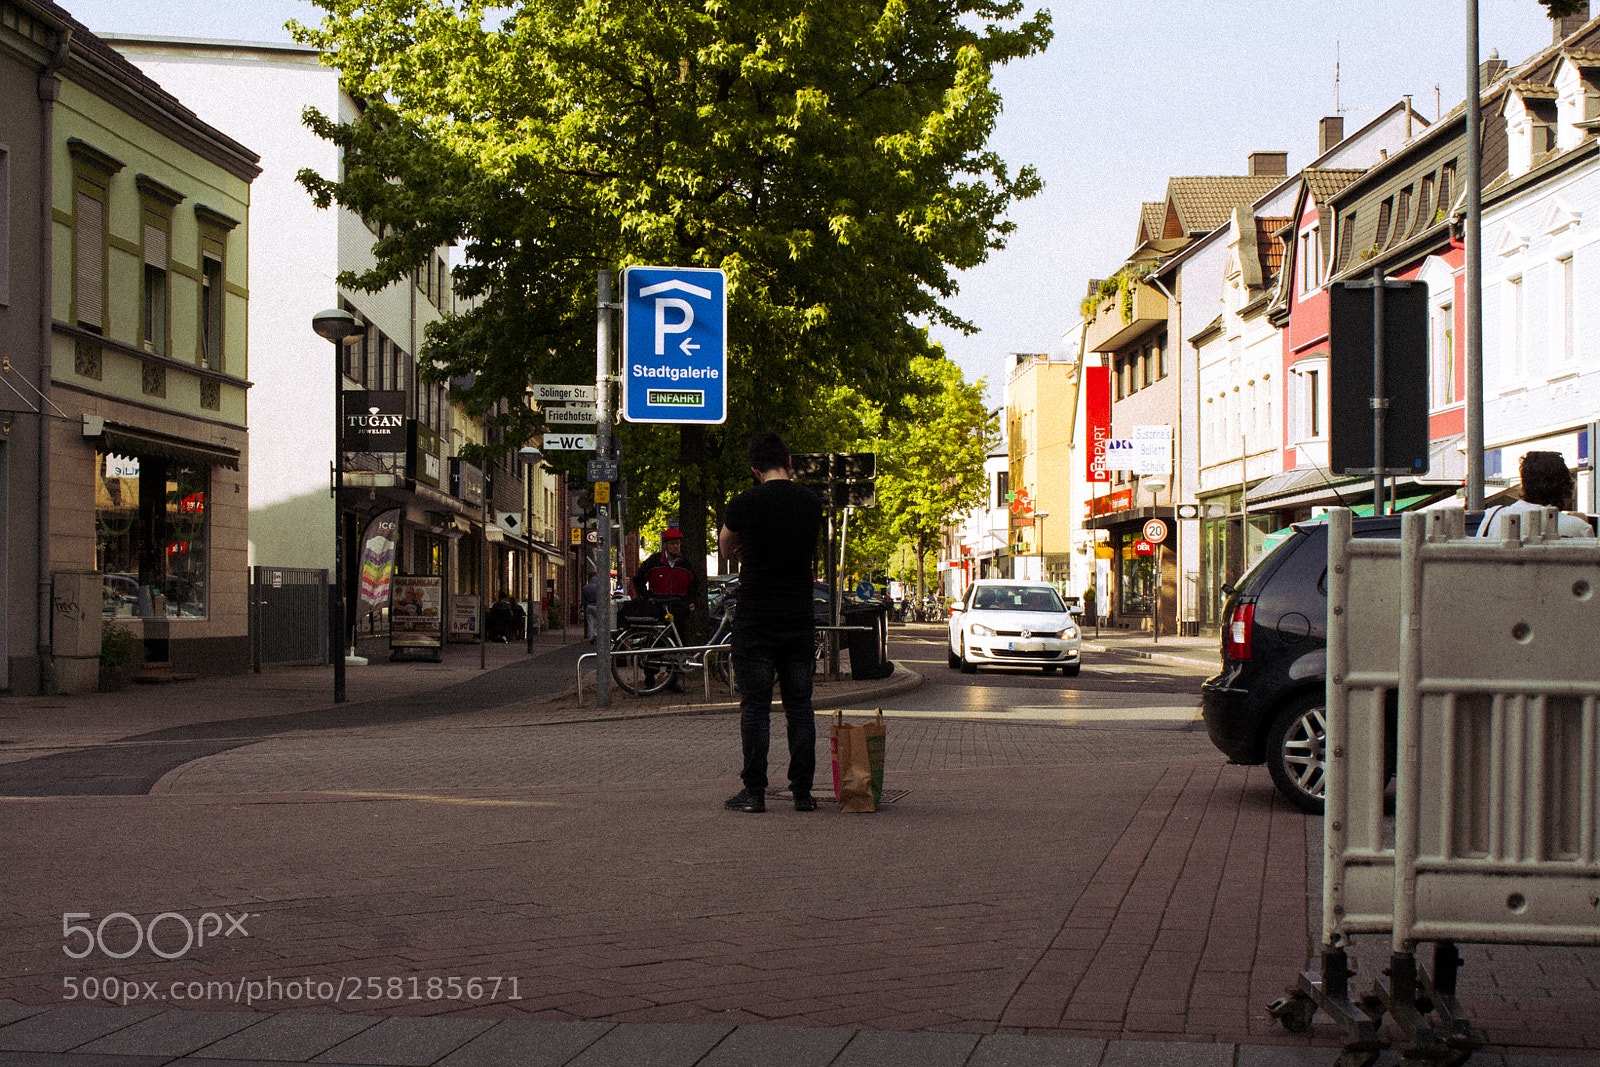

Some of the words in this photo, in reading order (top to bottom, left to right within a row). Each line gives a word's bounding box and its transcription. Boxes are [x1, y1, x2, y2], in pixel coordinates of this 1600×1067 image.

[655, 297, 695, 355] P
[632, 364, 719, 381] Stadtgalerie
[540, 387, 572, 400] Solinger
[574, 387, 589, 399] Str.
[649, 392, 701, 404] EINFAHRT
[347, 415, 403, 427] TUGAN
[548, 409, 594, 422] Friedhofstr.
[560, 437, 584, 449] WC
[1093, 426, 1106, 480] DERPART
[1149, 525, 1162, 537] 20
